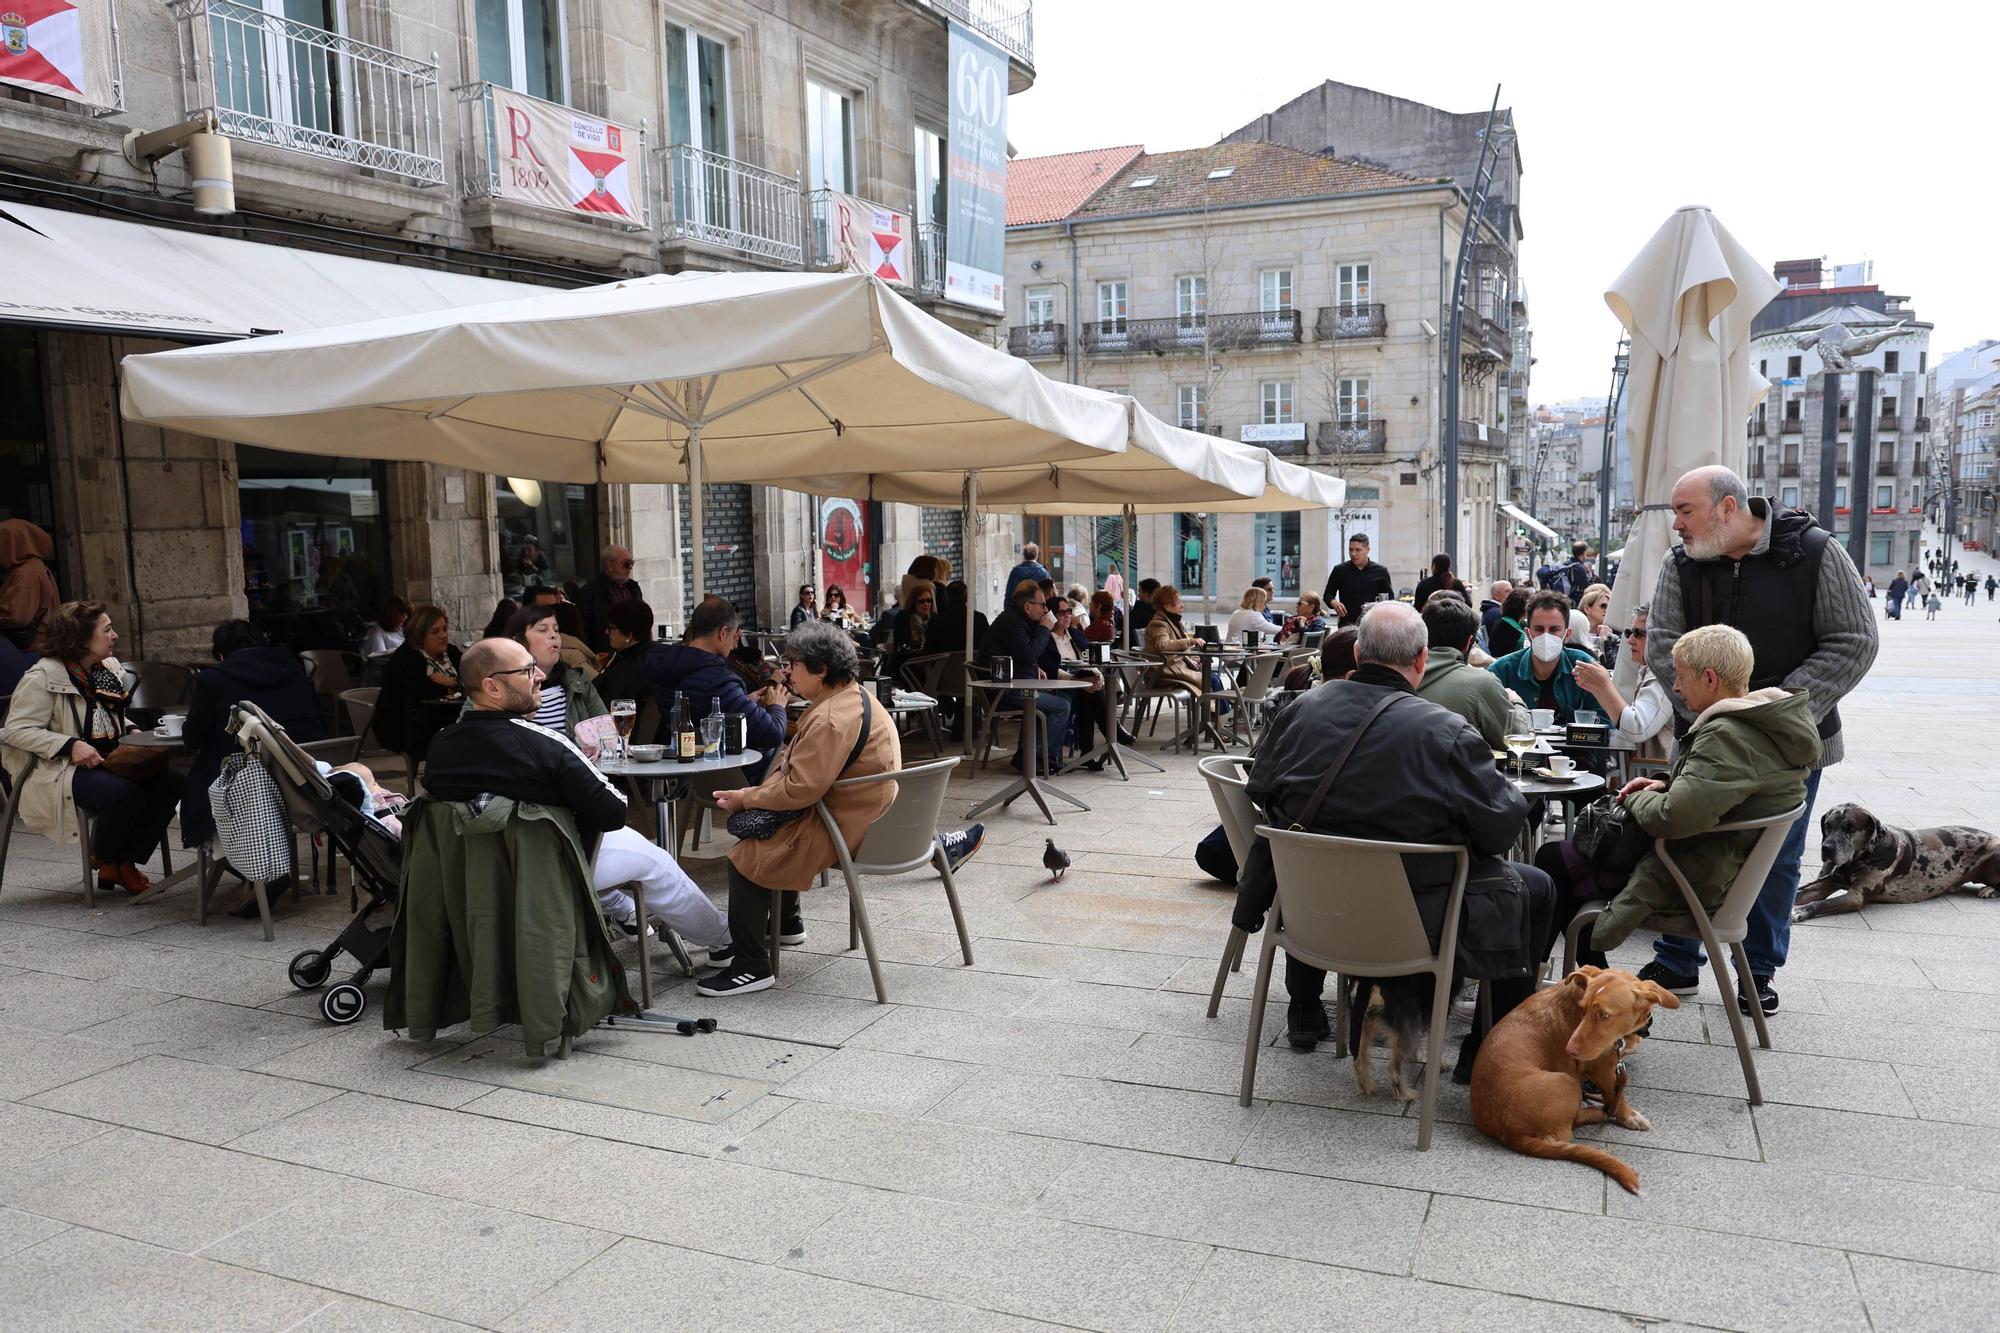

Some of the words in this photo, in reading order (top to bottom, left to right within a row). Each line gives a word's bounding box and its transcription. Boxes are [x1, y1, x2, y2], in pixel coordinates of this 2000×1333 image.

[957, 51, 1001, 128] 60
[505, 105, 546, 167] R
[574, 121, 604, 135] CONCELLO
[577, 131, 586, 140] DE
[587, 133, 601, 142] VIGO
[510, 166, 549, 190] 1809
[838, 204, 857, 248] R
[1334, 513, 1372, 521] DCIMAS
[1266, 525, 1277, 575] TENTH
